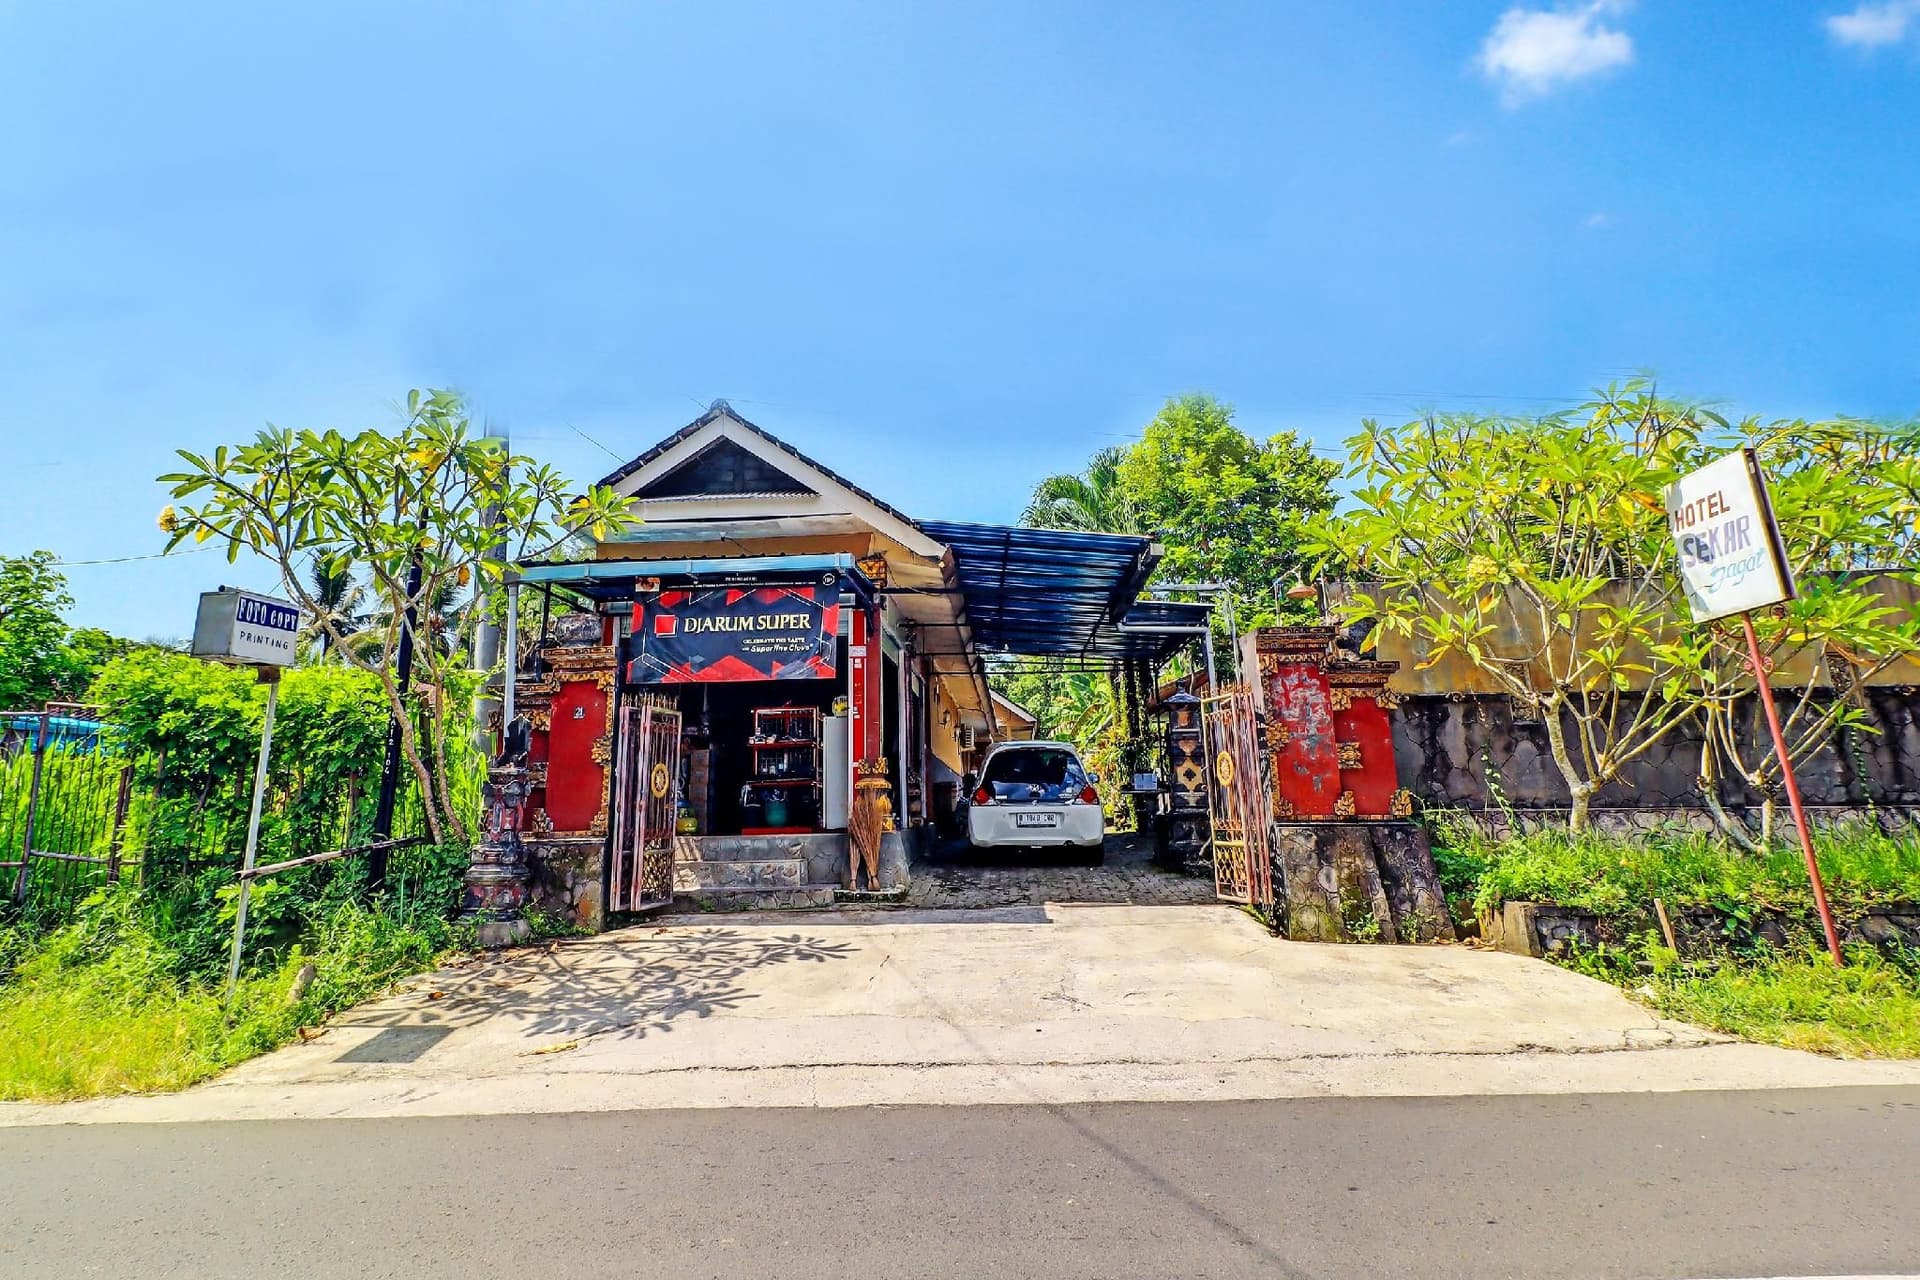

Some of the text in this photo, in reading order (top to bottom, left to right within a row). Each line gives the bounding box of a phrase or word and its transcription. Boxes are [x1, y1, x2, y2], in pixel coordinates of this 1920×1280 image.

[1674, 490, 1731, 532] HOTEL
[1681, 515, 1751, 568] SEKAR
[238, 598, 297, 630] FOTO COPY
[684, 613, 811, 633] DJARUM SUPER
[240, 630, 289, 650] PRINTING
